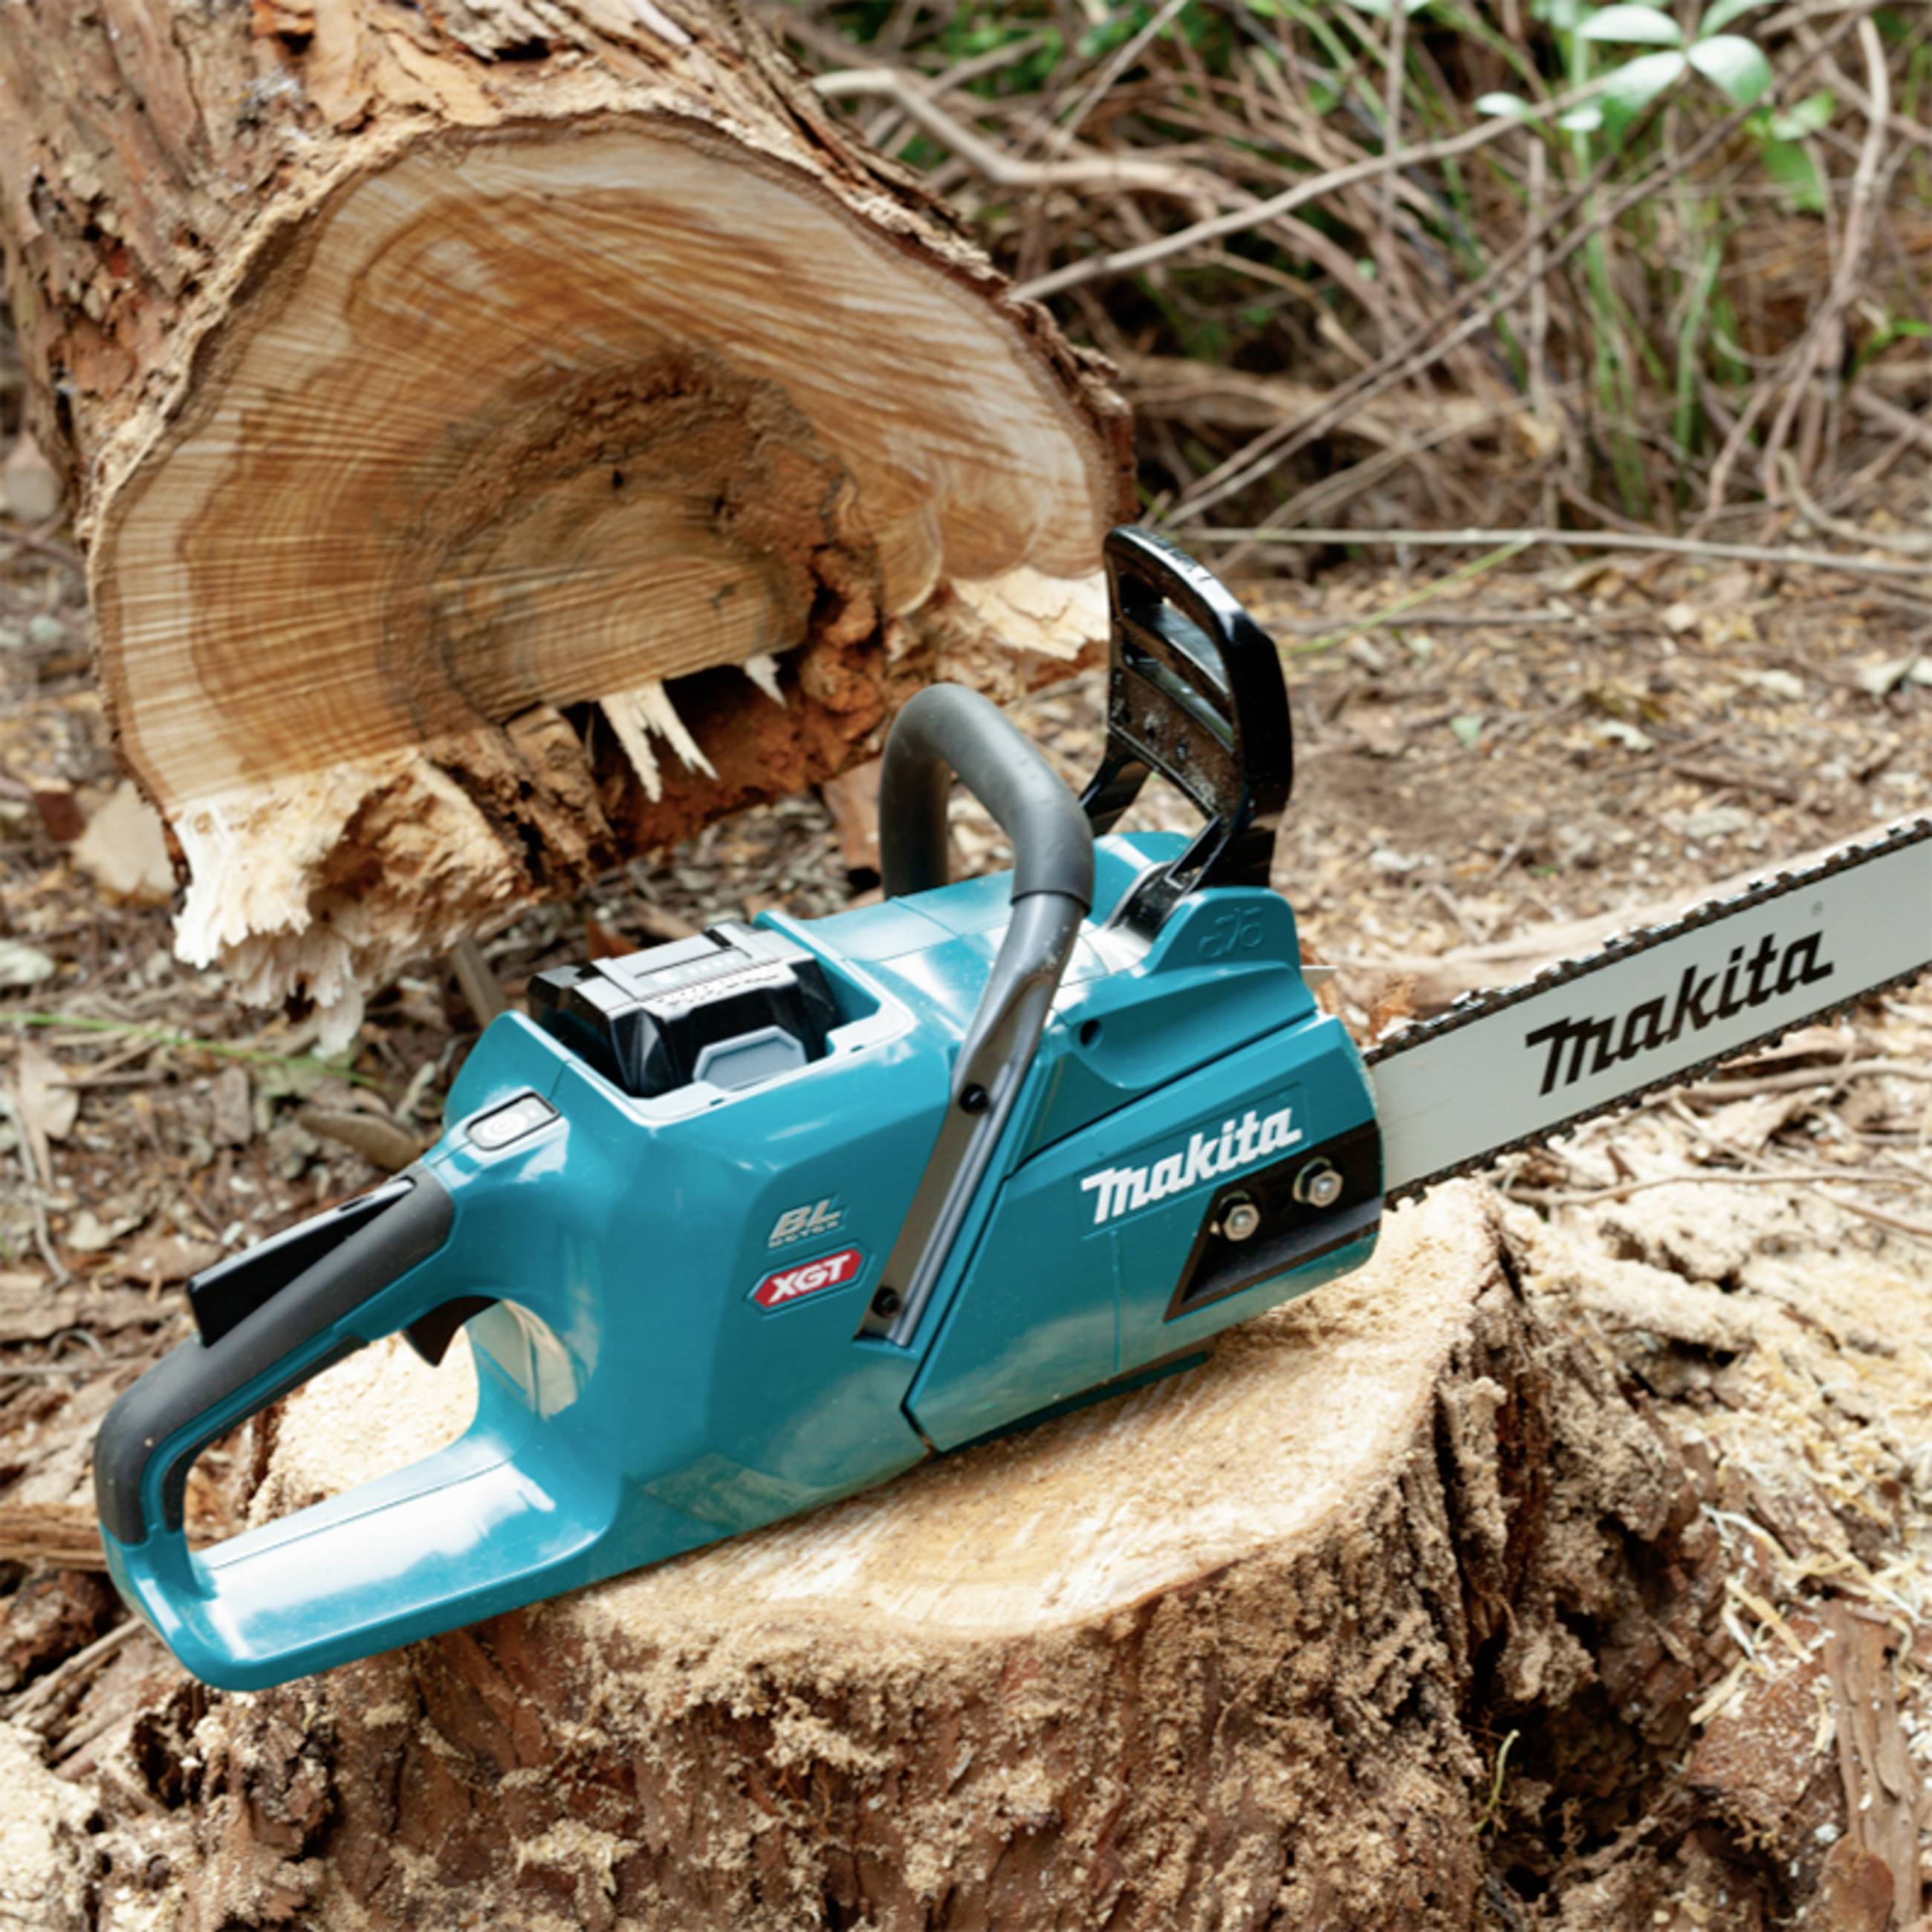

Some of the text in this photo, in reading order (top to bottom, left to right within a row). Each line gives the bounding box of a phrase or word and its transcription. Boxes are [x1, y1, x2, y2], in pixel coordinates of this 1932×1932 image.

[1526, 930, 1833, 1097] Makita
[1080, 1107, 1302, 1225] Makita
[768, 1199, 841, 1240] BL
[768, 1253, 851, 1303] XGT
